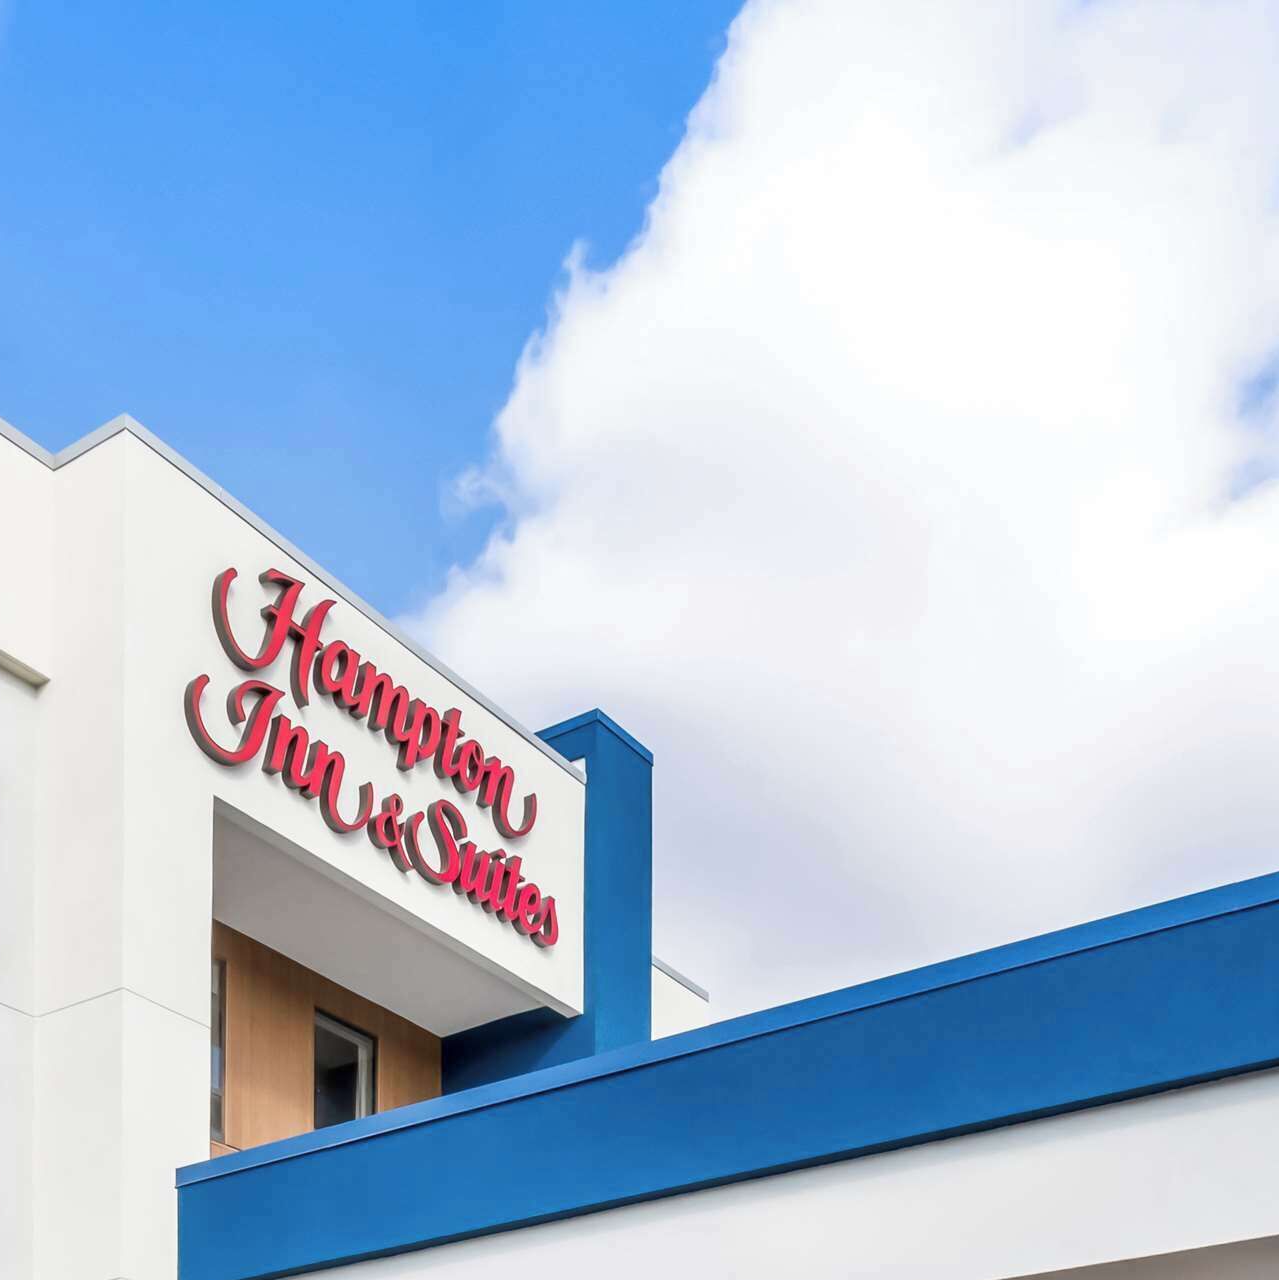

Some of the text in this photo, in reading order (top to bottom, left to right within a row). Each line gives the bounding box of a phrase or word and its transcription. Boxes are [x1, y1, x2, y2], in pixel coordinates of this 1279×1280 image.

[184, 673, 373, 833] Inn
[404, 799, 559, 948] Suites
[212, 567, 537, 838] Hampton
